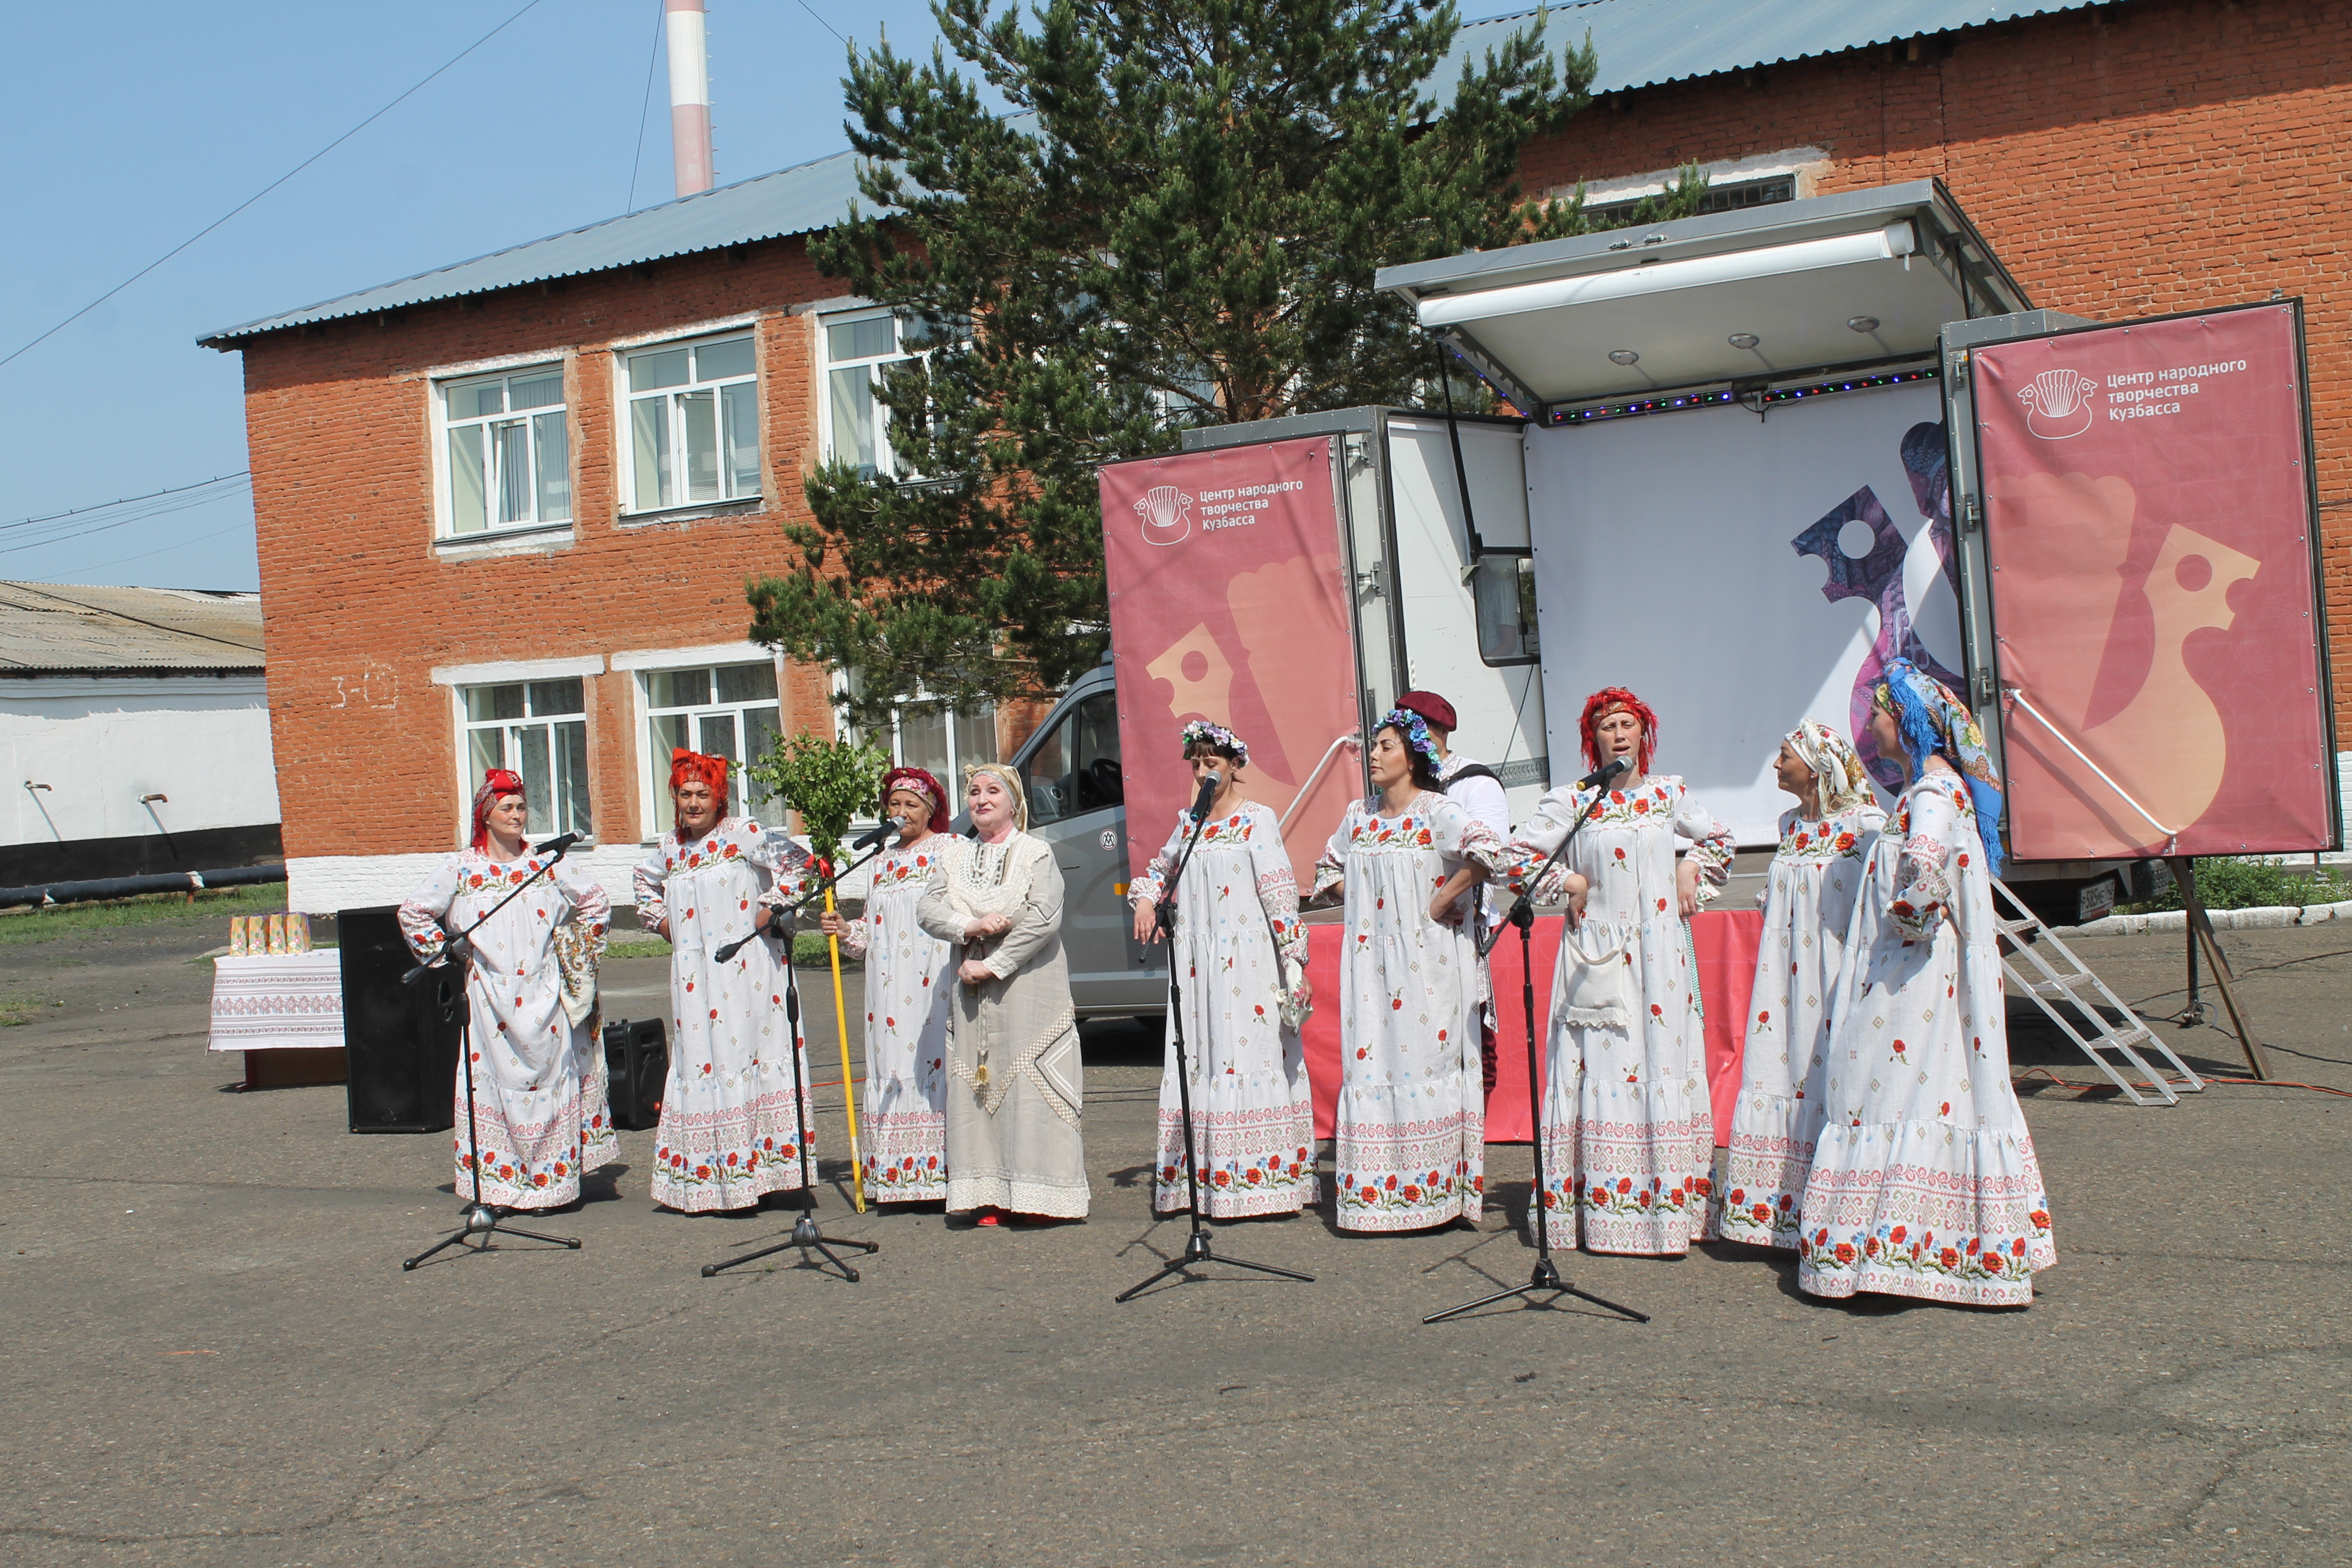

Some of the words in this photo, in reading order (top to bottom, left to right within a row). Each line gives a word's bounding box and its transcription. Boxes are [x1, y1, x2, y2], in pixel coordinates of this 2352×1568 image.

[2107, 371, 2154, 389] Центр
[2158, 360, 2247, 382] народного
[2107, 383, 2199, 404] творчества
[2109, 402, 2180, 422] Кузбасса
[1200, 488, 1235, 503] Центр
[1238, 480, 1303, 498] народного
[1200, 499, 1268, 516] творчества
[1202, 515, 1255, 531] Кузбасса
